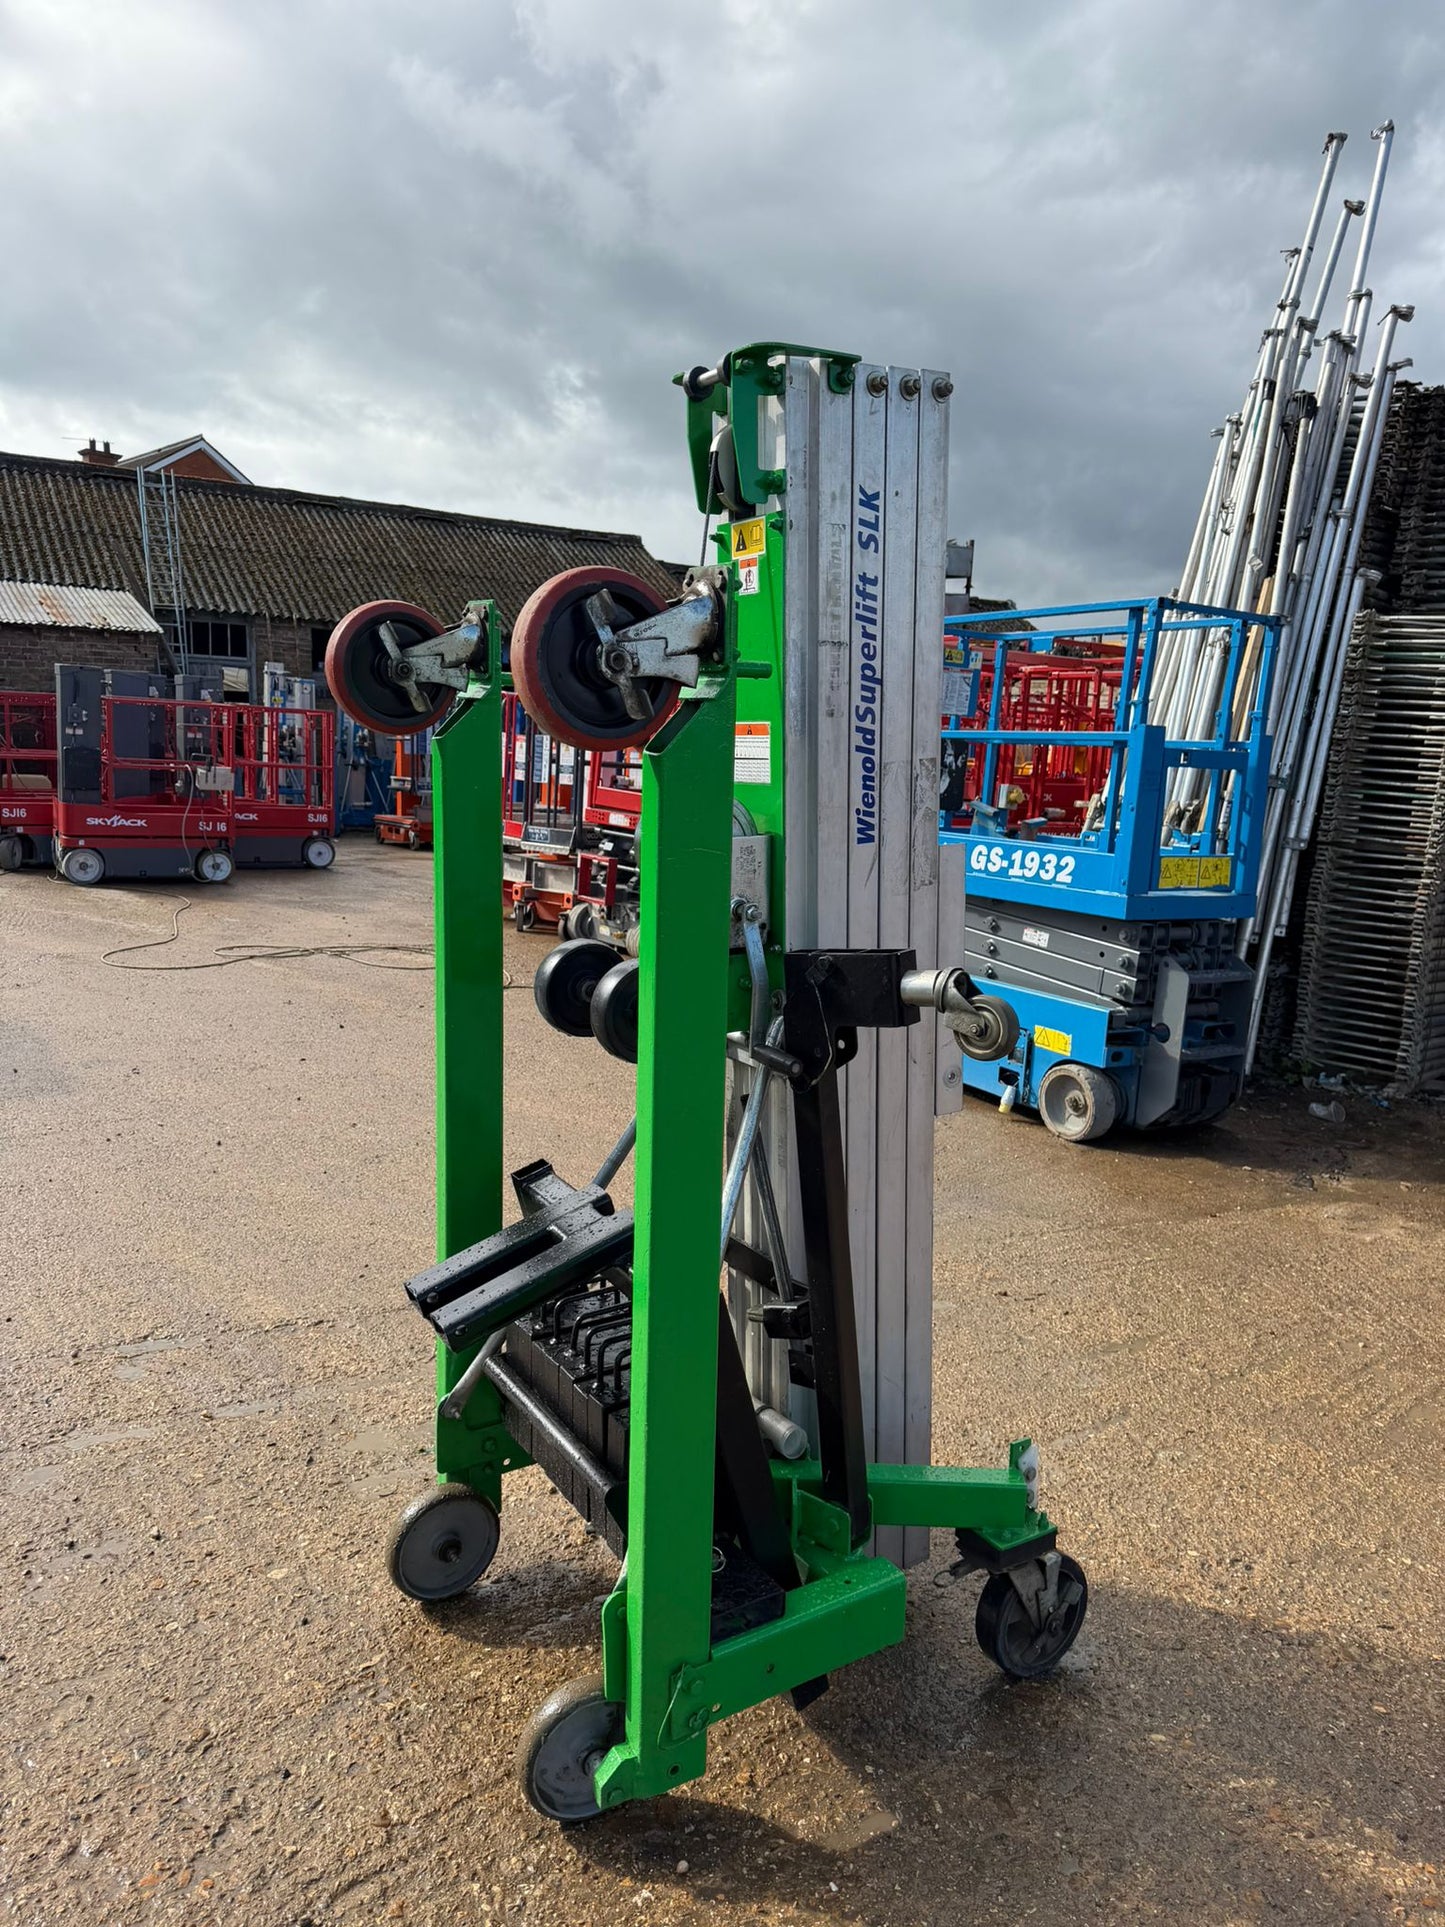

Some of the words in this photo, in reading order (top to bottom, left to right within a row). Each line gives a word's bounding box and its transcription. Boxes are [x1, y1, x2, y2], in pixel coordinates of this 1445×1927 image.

[857, 484, 881, 554] SLK
[86, 815, 148, 827] SKYJACK
[970, 844, 1076, 884] GS-1932
